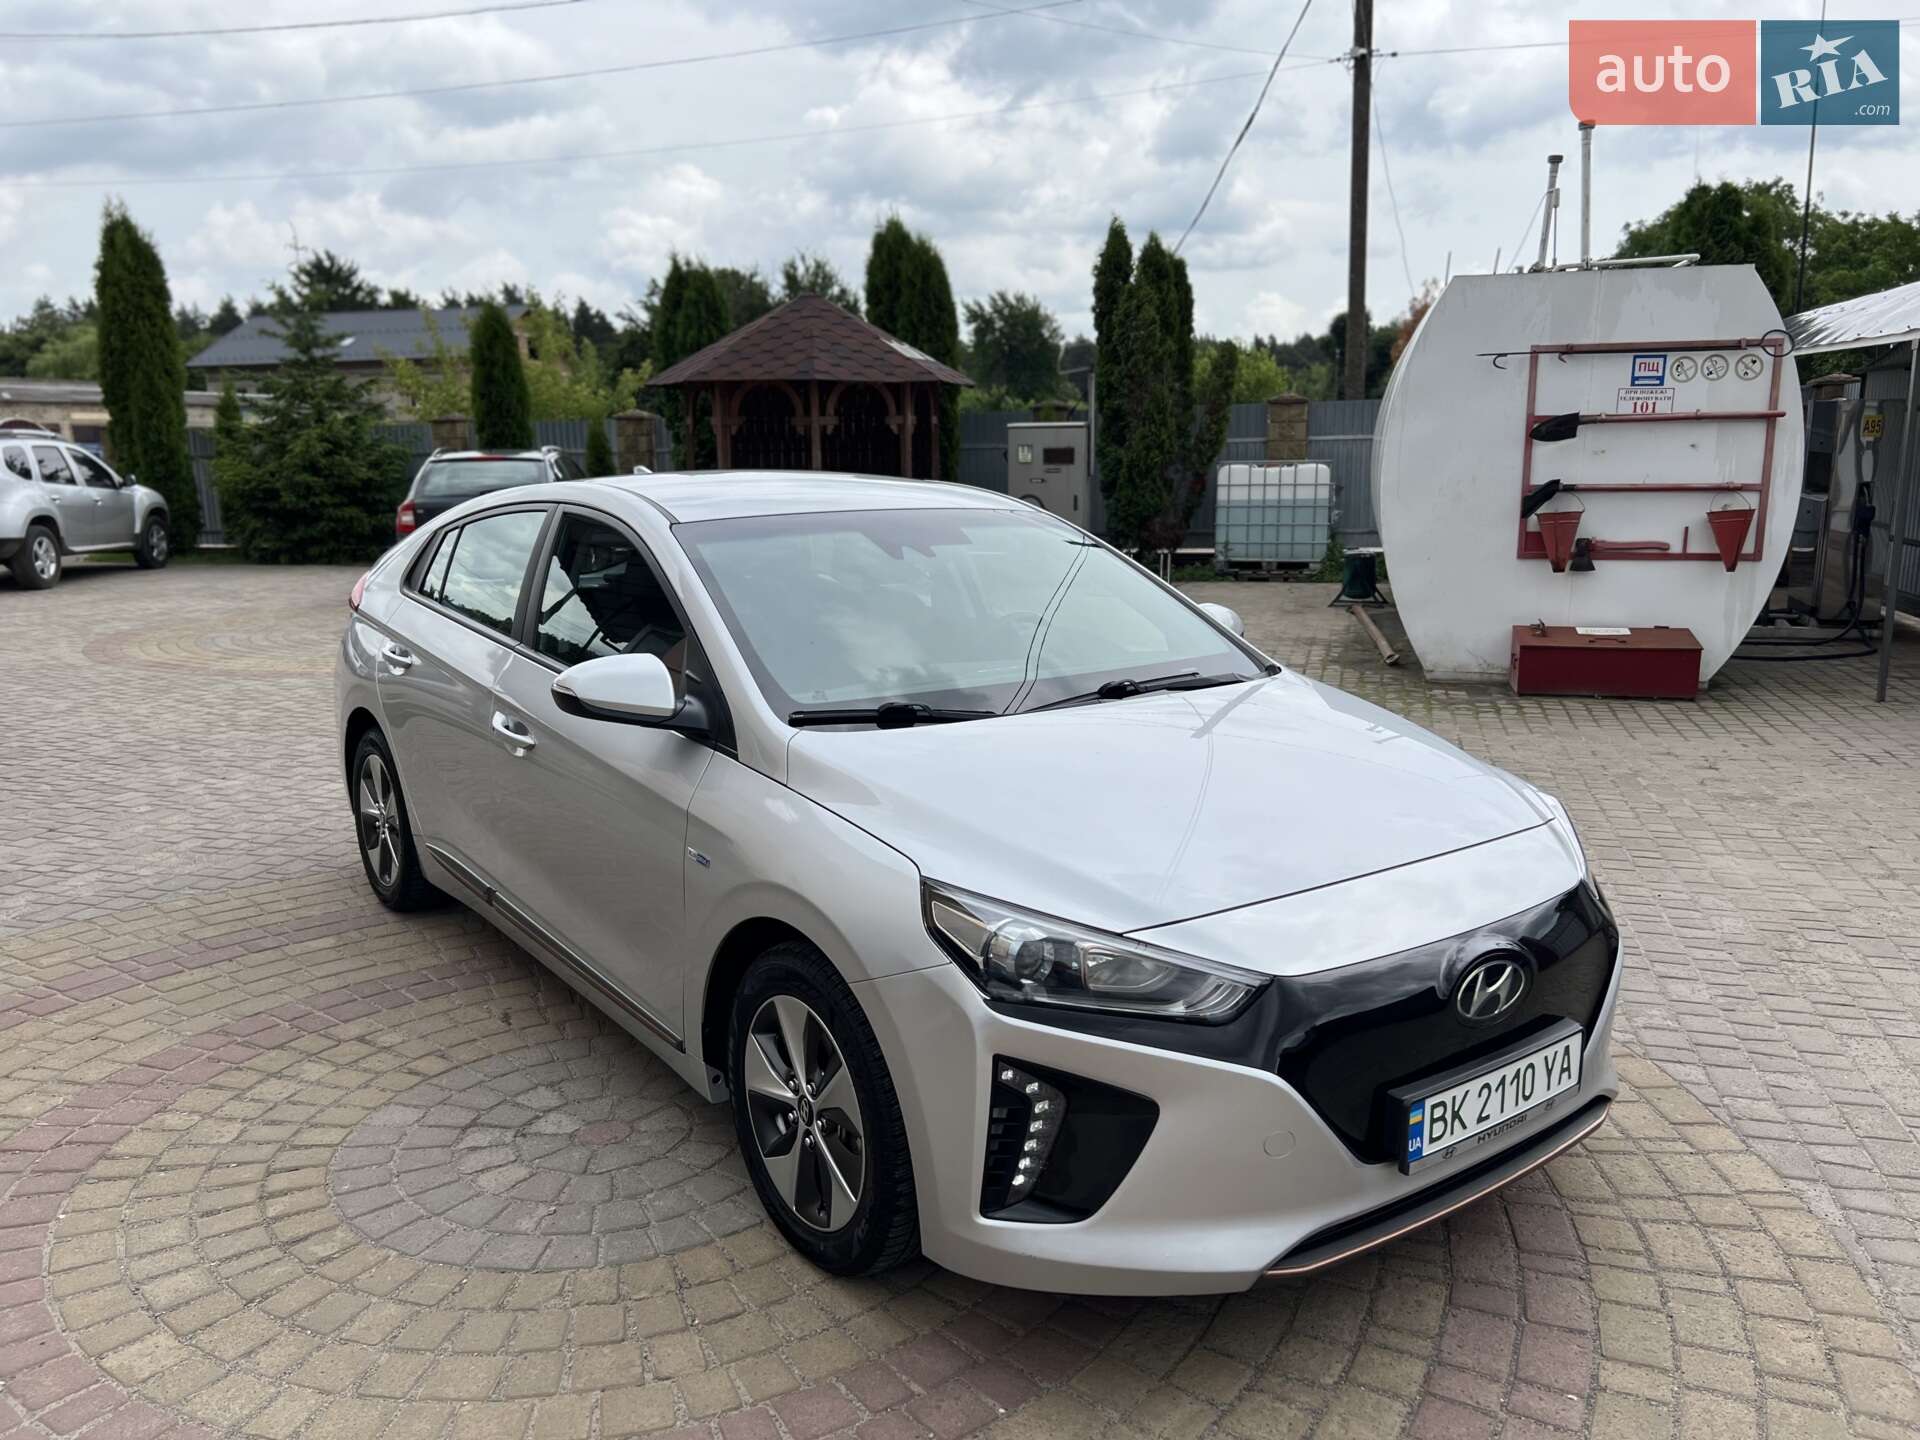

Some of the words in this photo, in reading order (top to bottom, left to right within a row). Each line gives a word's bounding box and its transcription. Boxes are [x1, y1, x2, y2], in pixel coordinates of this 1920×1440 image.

[1638, 361, 1660, 373] ПЩ
[1632, 401, 1657, 414] 101
[1428, 1089, 1469, 1144] BK
[1476, 1062, 1536, 1125] 2110
[1544, 1044, 1573, 1092] YA
[1477, 1114, 1528, 1144] HYUNDAI
[1408, 1138, 1422, 1151] UA
